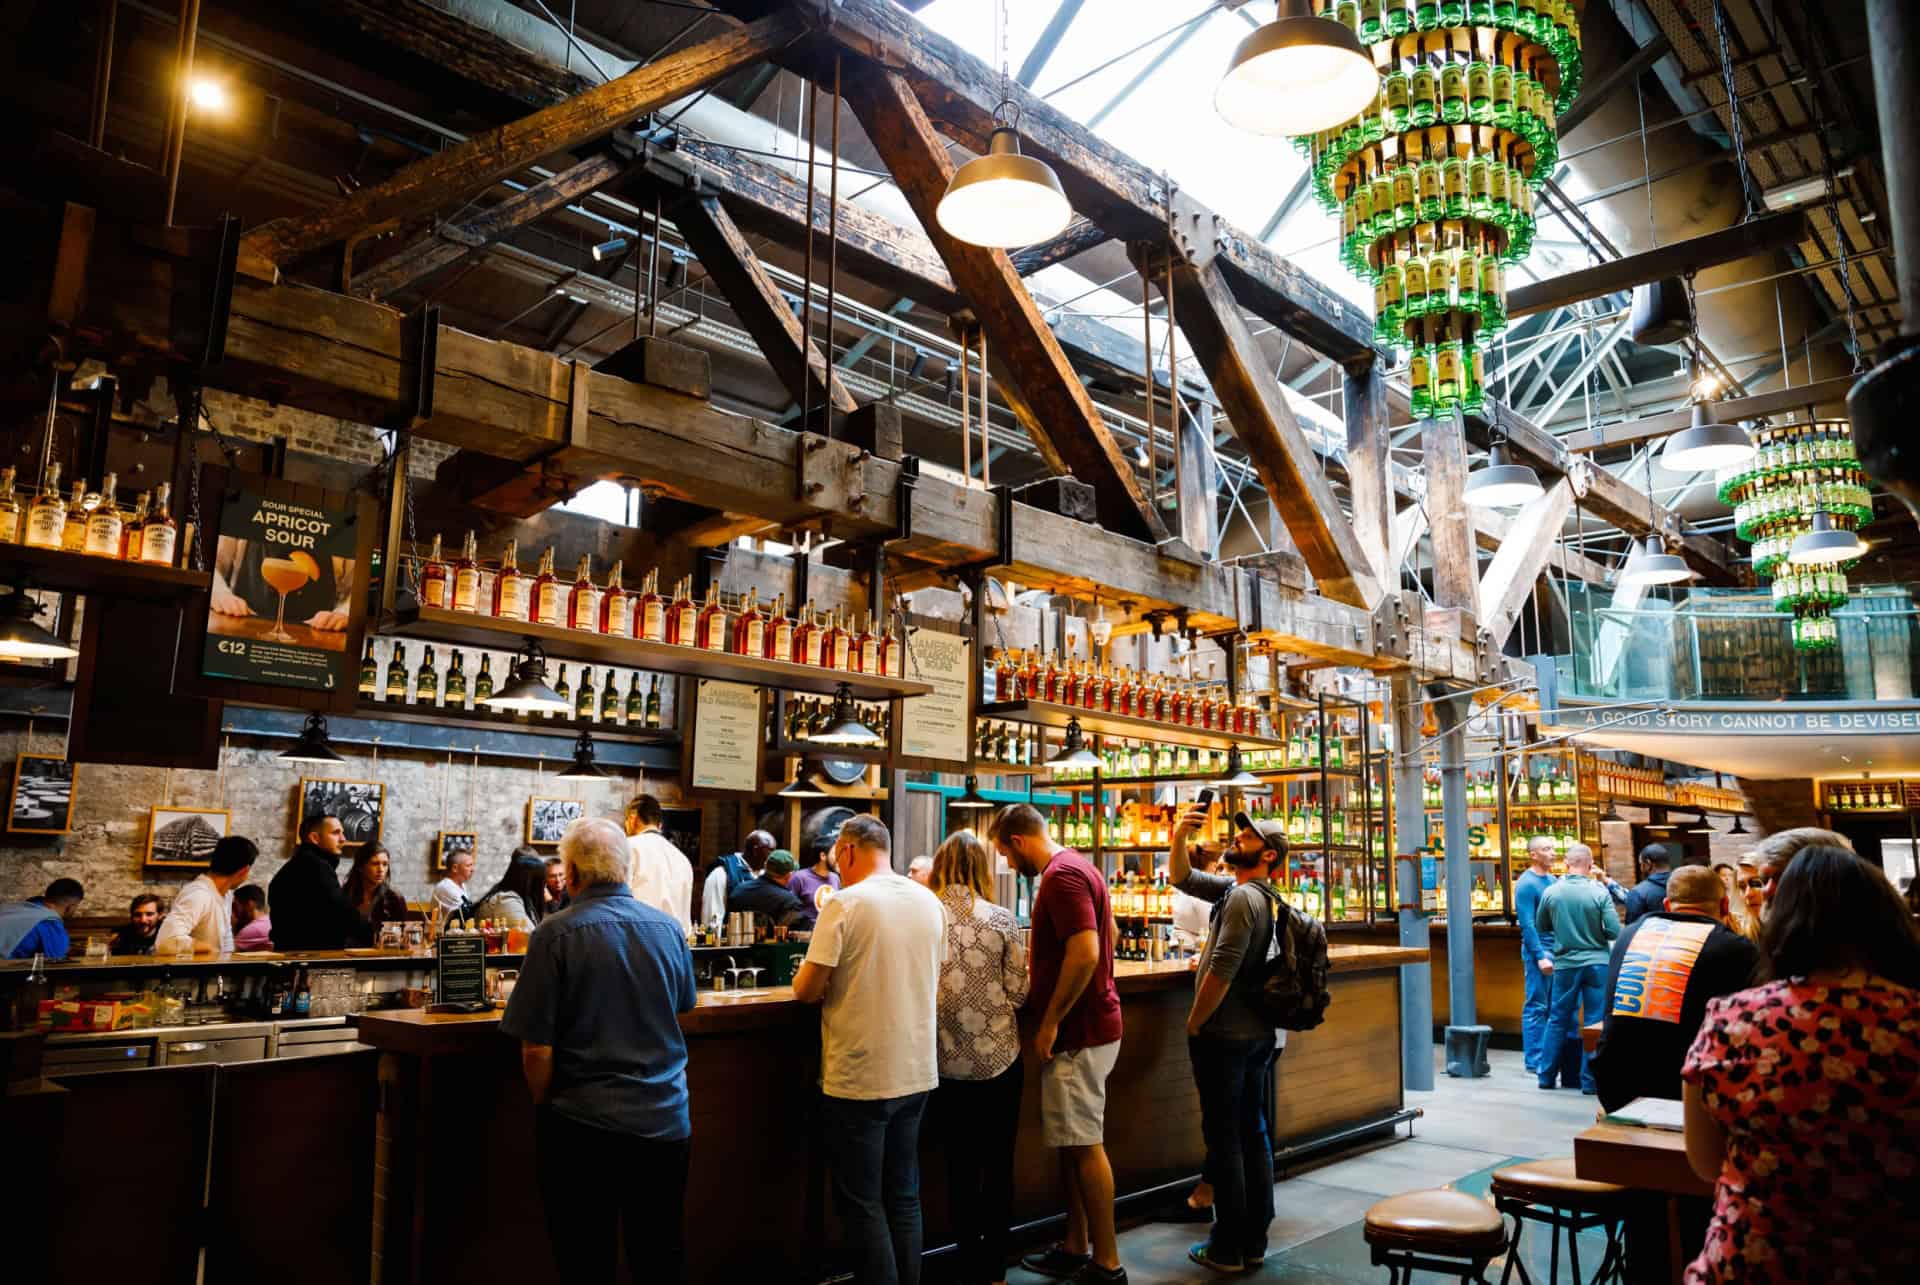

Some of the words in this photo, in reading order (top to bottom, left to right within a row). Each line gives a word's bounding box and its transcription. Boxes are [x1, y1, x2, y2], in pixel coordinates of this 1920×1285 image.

[262, 501, 287, 512] SOUR
[288, 505, 324, 519] SPECIAL
[252, 509, 332, 536] APRICOT
[265, 528, 314, 549] SOUR
[218, 640, 246, 655] €12
[1602, 711, 1649, 726] GOOD
[1721, 713, 1797, 729] CANNOT
[1805, 714, 1832, 729] BE
